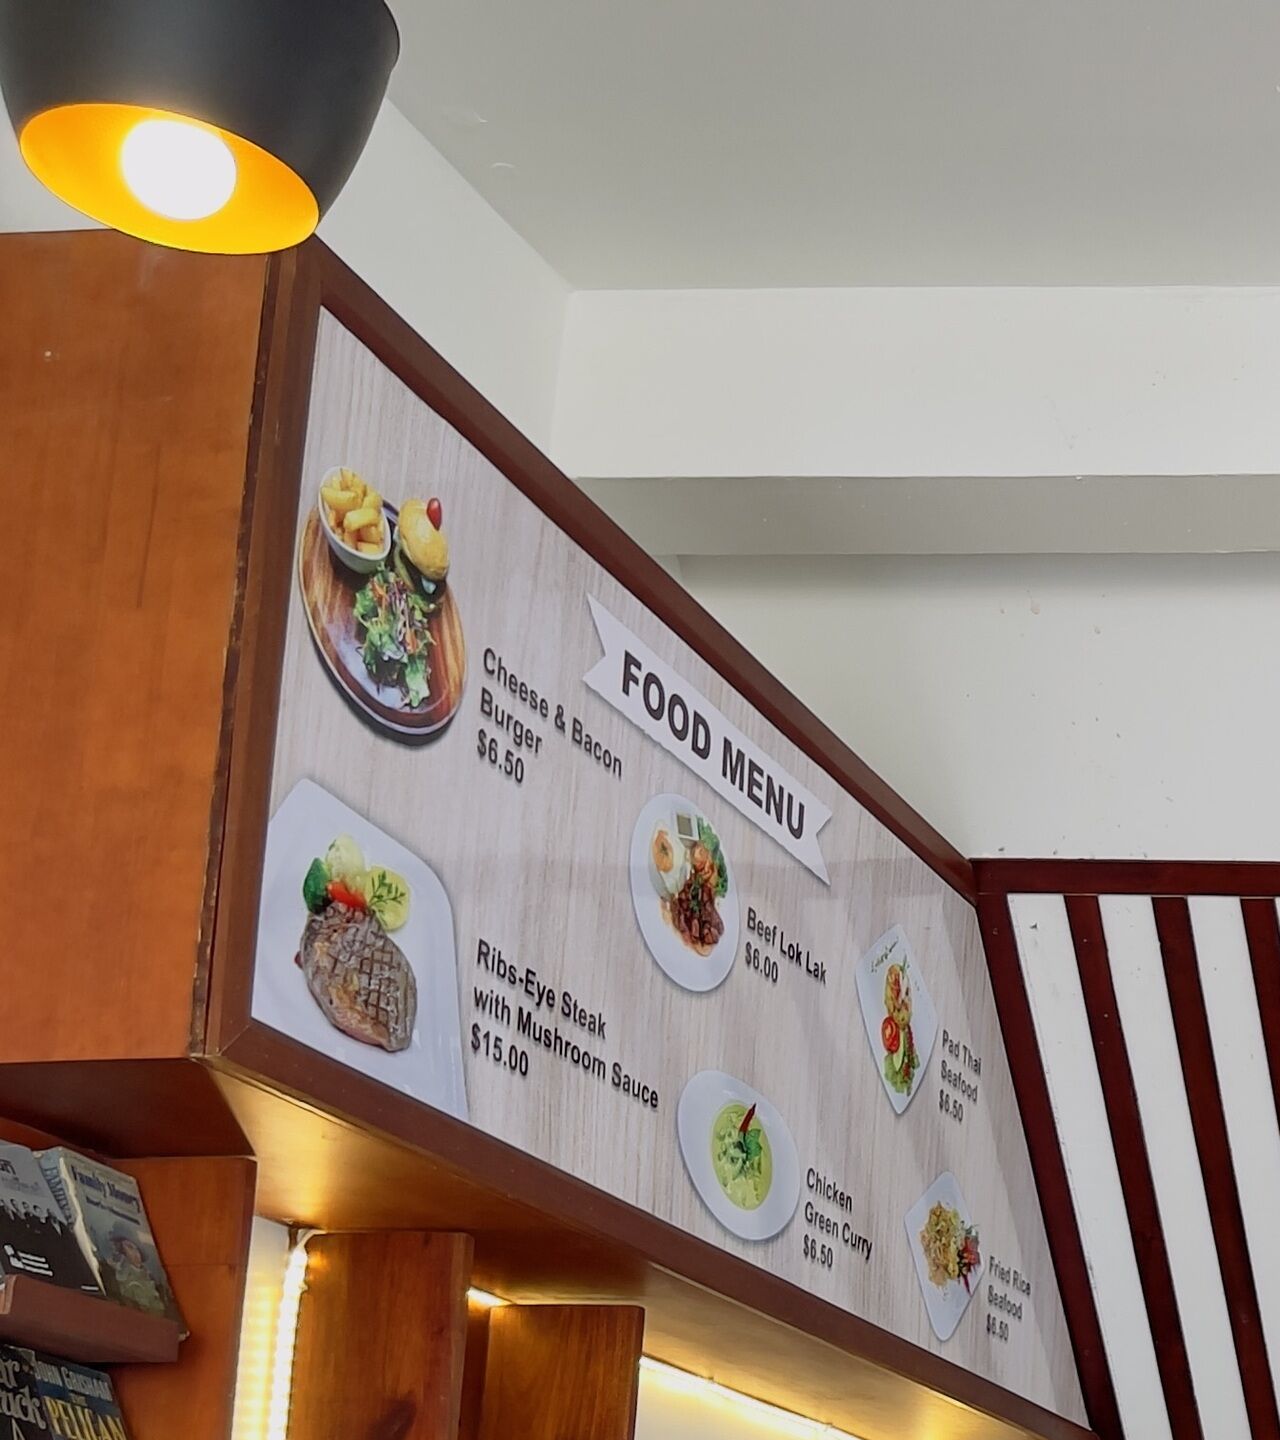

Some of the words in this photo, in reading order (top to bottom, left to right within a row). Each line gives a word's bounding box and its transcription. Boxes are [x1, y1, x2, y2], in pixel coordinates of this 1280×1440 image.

[480, 686, 542, 754] Burger
[483, 647, 549, 719] Cheese
[554, 704, 566, 734] &
[572, 717, 622, 778] Bacon
[477, 728, 524, 785] $6.50
[622, 649, 711, 760] FOOD
[721, 736, 805, 840] MENU
[745, 941, 778, 984] $6.00
[747, 906, 777, 947] Beef
[780, 931, 802, 967] Lok
[806, 950, 826, 985] Lak
[477, 938, 555, 1009] Ribs-Eye
[561, 991, 607, 1040] Steak
[471, 1022, 529, 1077] $15.00
[474, 986, 511, 1026] with
[517, 1006, 606, 1081] Mushroom
[611, 1062, 659, 1109] Sauce
[943, 1030, 960, 1059] Pad
[963, 1045, 982, 1076] Thai
[938, 1089, 964, 1124] $6.50
[940, 1059, 978, 1103] Seafood
[806, 1167, 853, 1213] Chicken
[803, 1233, 833, 1269] $6.50
[804, 1201, 839, 1239] Green
[842, 1222, 873, 1261] Curry
[987, 1285, 1023, 1322] Seafood
[988, 1256, 1010, 1287] Fried
[1012, 1269, 1031, 1296] Rice
